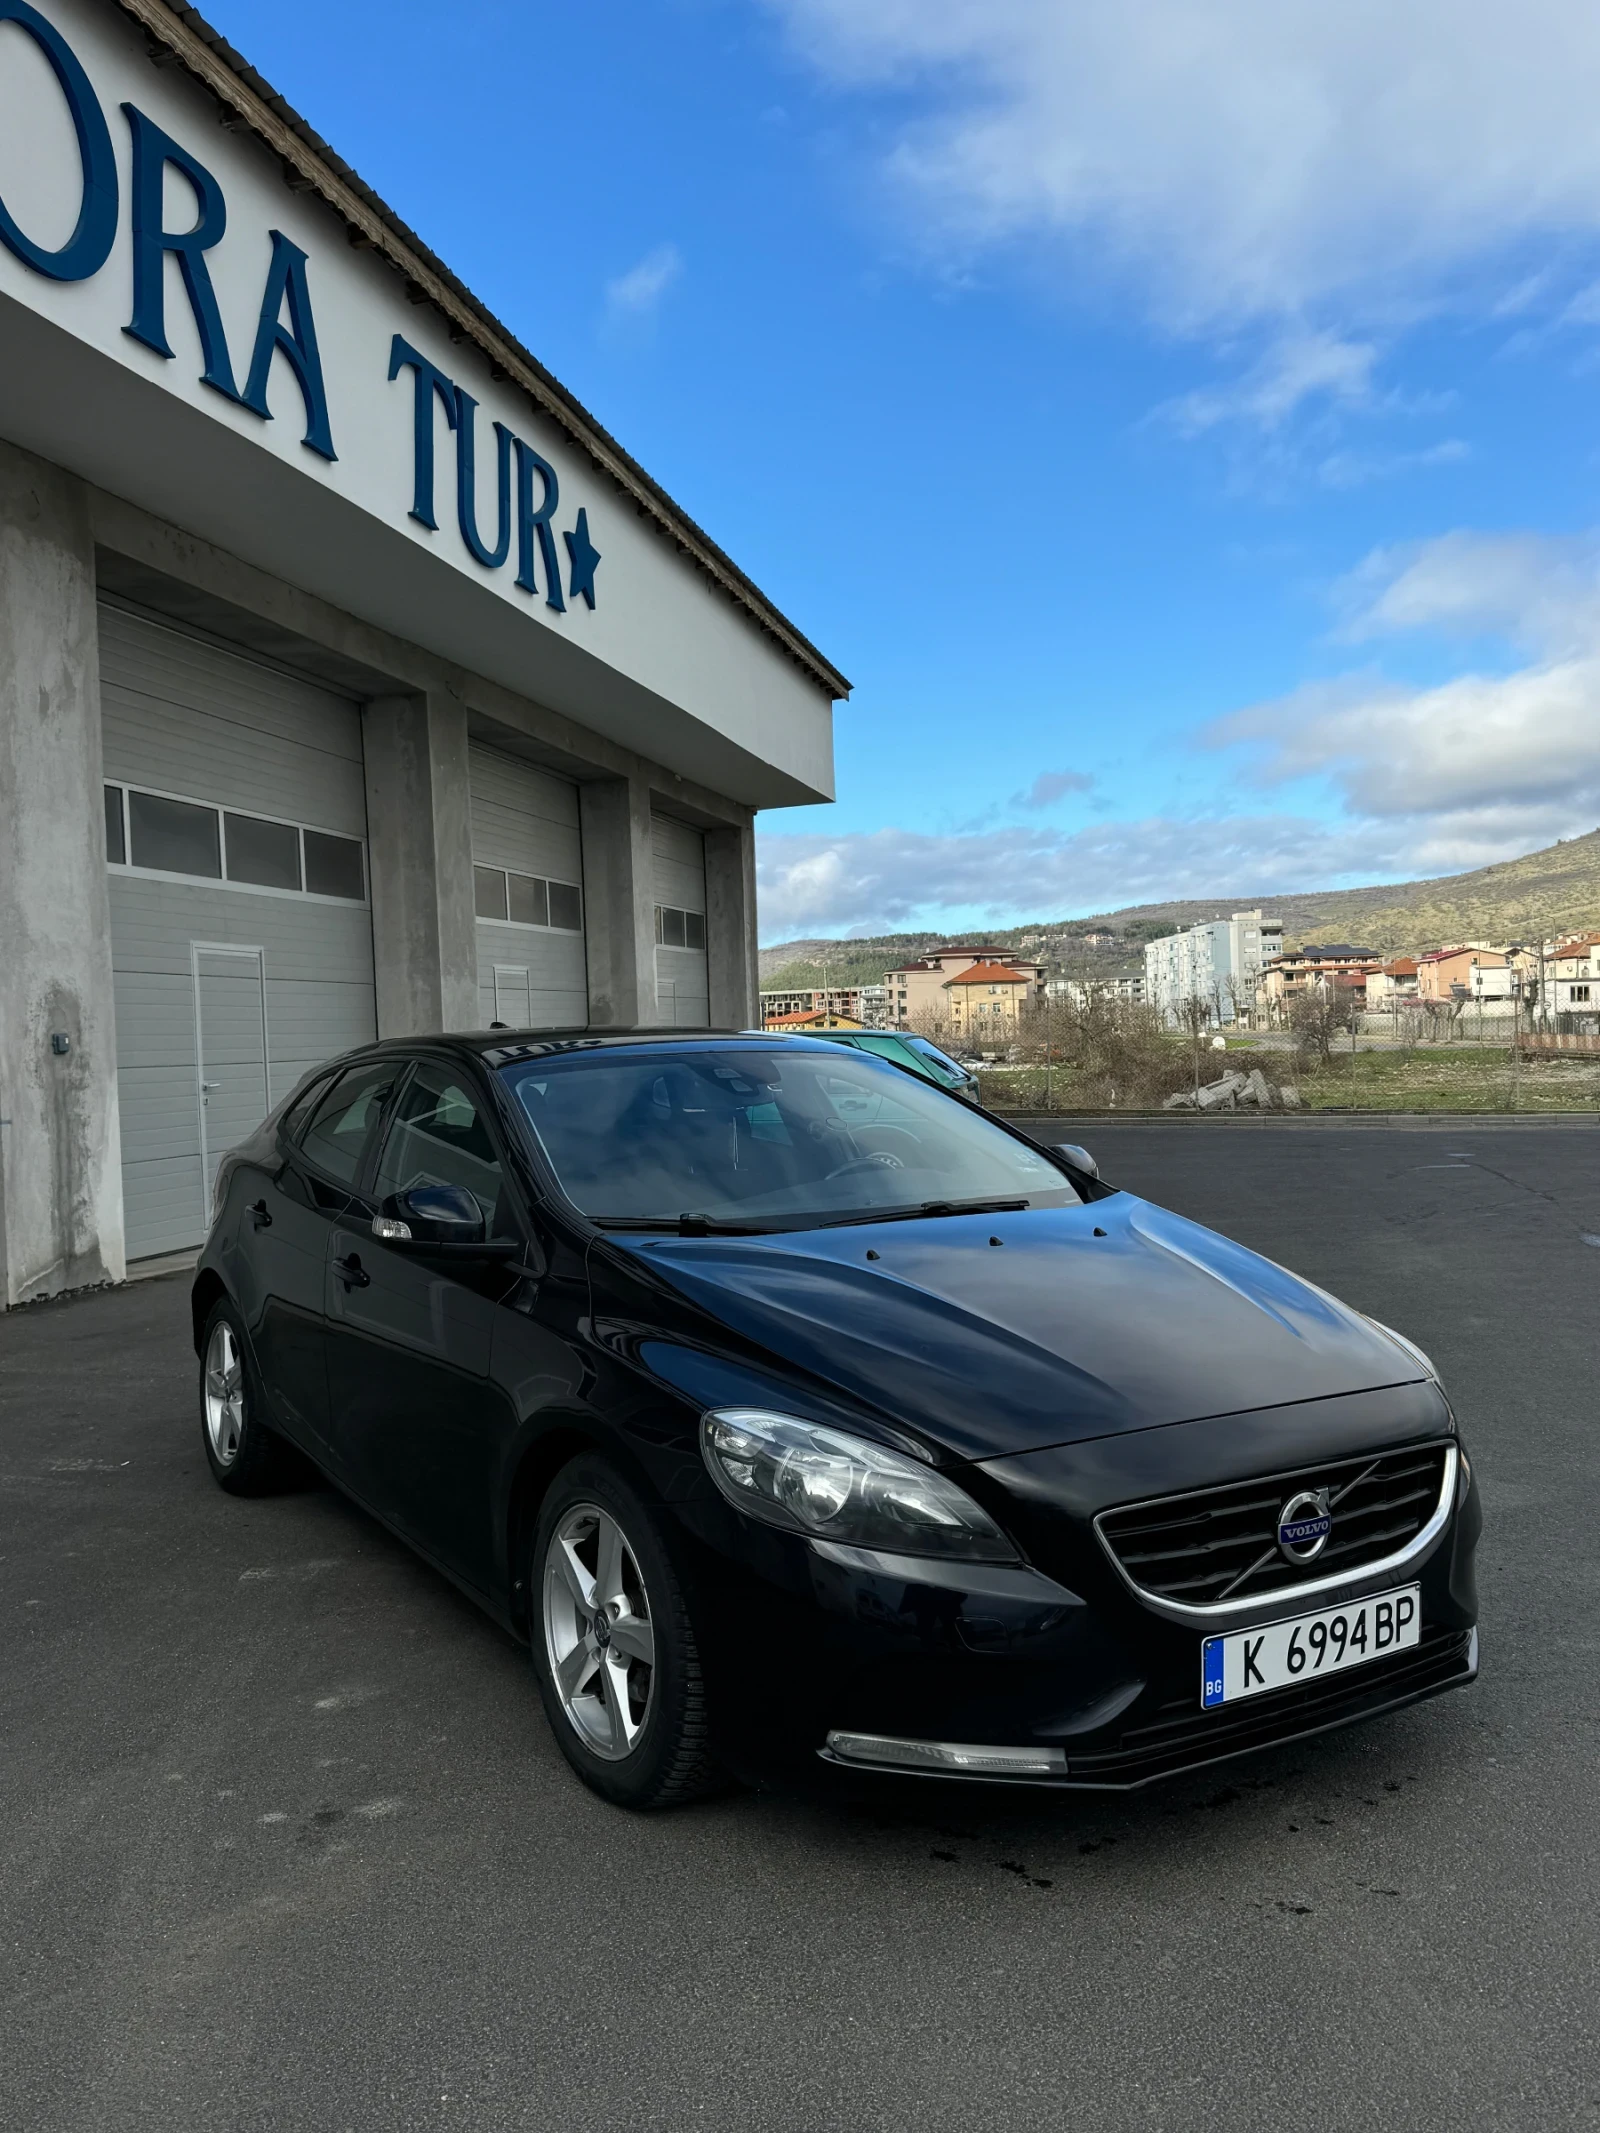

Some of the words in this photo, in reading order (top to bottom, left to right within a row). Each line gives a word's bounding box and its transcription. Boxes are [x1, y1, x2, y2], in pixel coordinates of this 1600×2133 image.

[0, 0, 338, 462] ORA
[388, 334, 566, 612] TUR
[1284, 1520, 1328, 1538] VOLVO
[1243, 1635, 1266, 1688] K
[1206, 1679, 1222, 1696] BG
